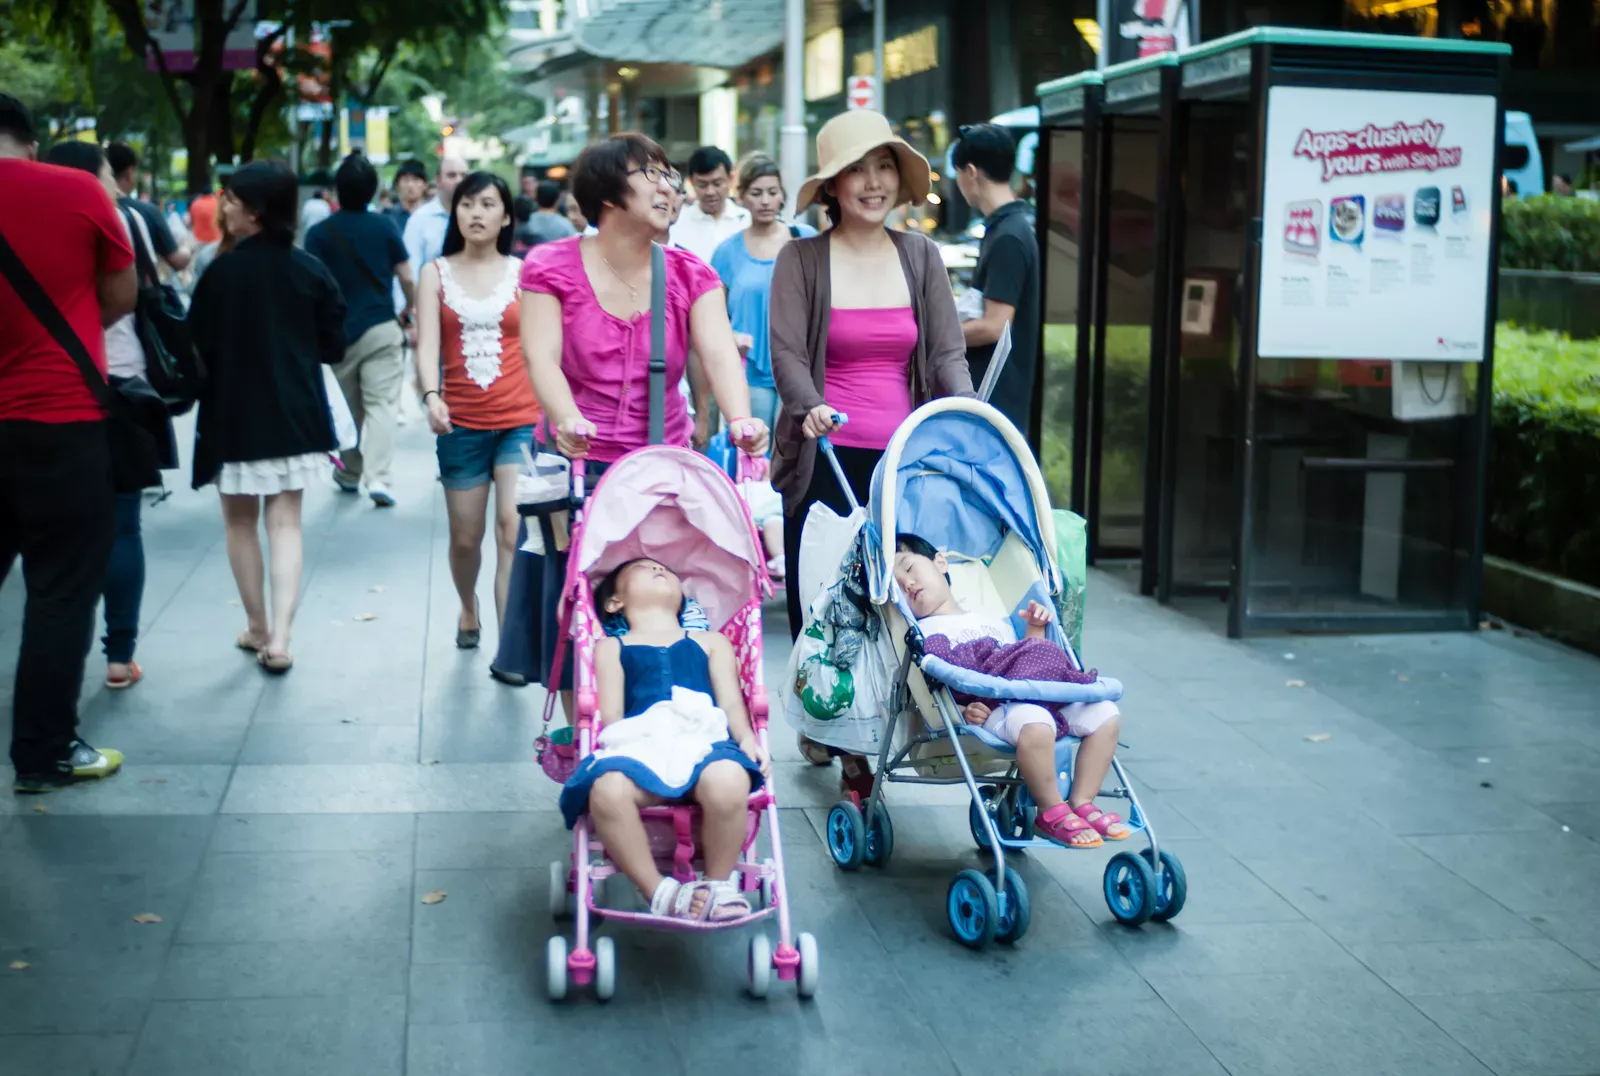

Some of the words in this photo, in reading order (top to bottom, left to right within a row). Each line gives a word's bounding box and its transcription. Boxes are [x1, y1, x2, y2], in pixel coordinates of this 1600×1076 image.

[1296, 120, 1443, 157] Apps-clusively
[1323, 153, 1381, 181] yours
[1382, 154, 1409, 169] with
